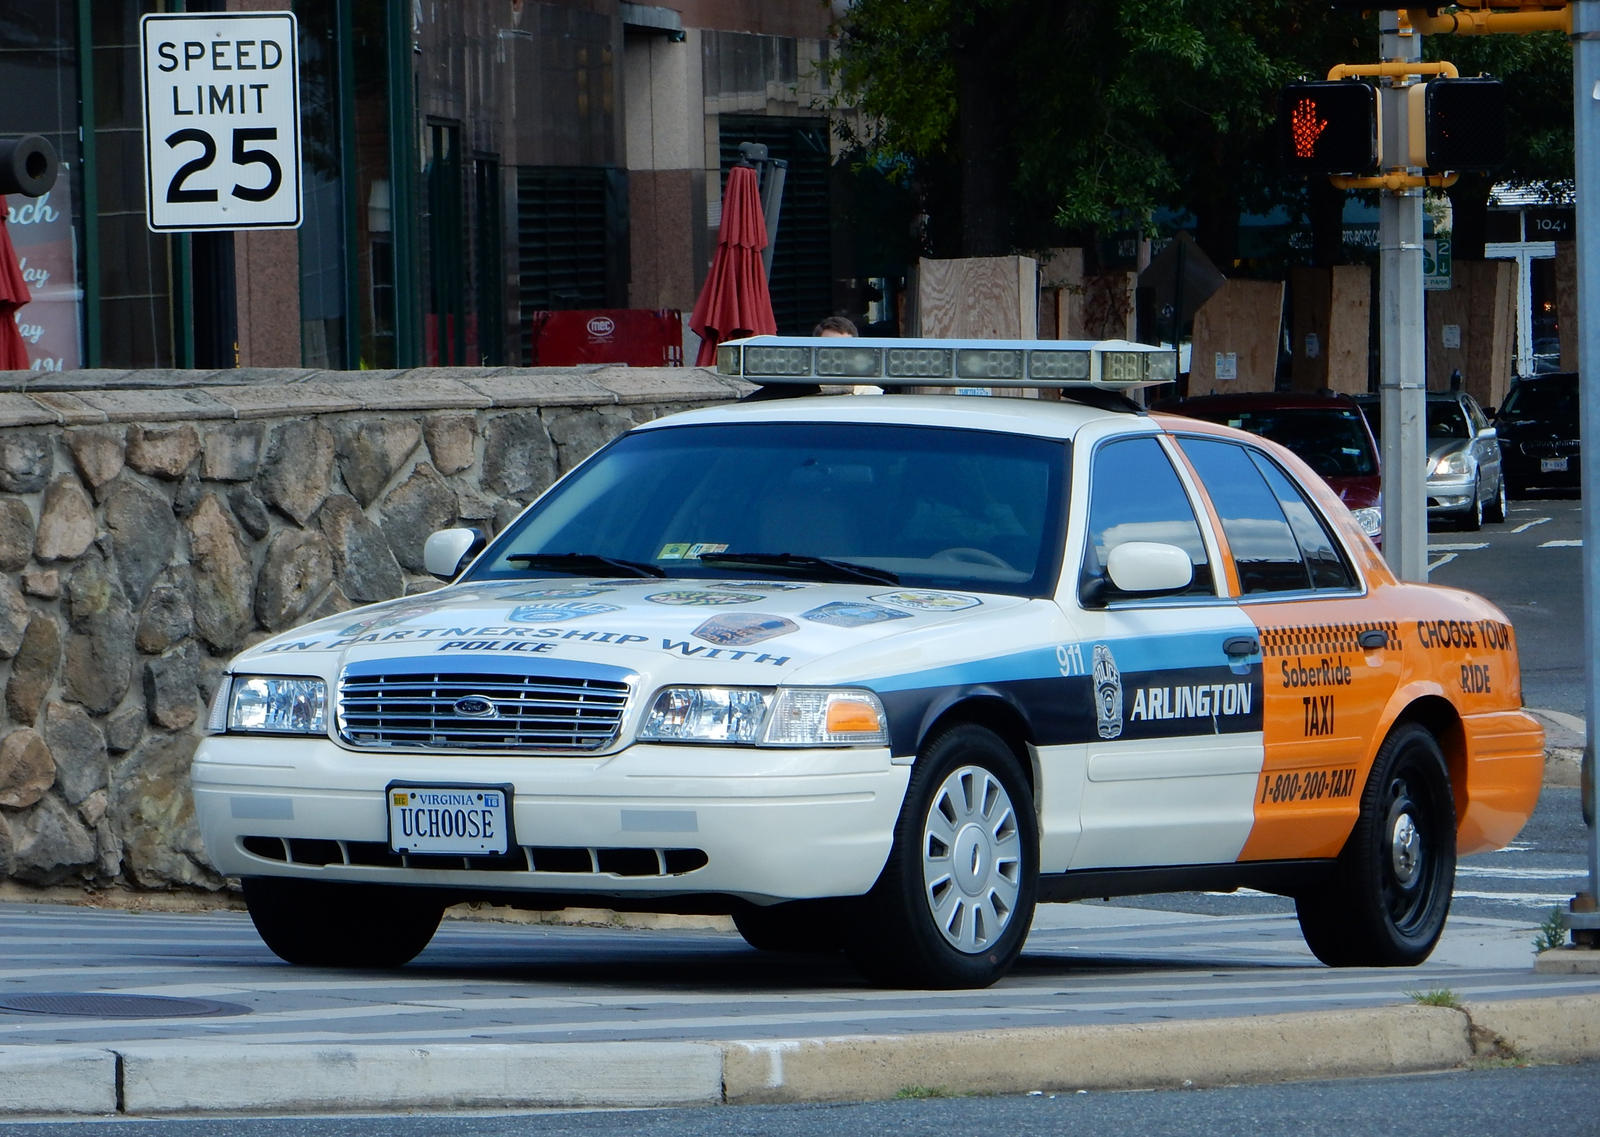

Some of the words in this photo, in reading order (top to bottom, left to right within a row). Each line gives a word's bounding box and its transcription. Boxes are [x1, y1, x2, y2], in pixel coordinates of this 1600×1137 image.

[158, 40, 282, 72] SPEED
[173, 84, 269, 115] LIMIT
[165, 127, 282, 203] 25
[1438, 242, 1449, 255] 2
[263, 641, 322, 653] IN
[325, 627, 649, 649] PARTNERSHIP
[662, 639, 791, 666] WITH
[437, 641, 558, 653] POLICE
[1417, 620, 1477, 649] CHOOSE
[1478, 621, 1512, 651] YOUR
[1056, 644, 1085, 677] 911
[1094, 660, 1119, 687] POLICE
[1281, 656, 1352, 688] SoberRide
[1461, 664, 1491, 694] RIDE
[1130, 683, 1252, 721] ARLINGTON
[1303, 695, 1334, 736] TAXI
[420, 794, 475, 805] VIRGINIA
[401, 808, 495, 838] UCHOOSE
